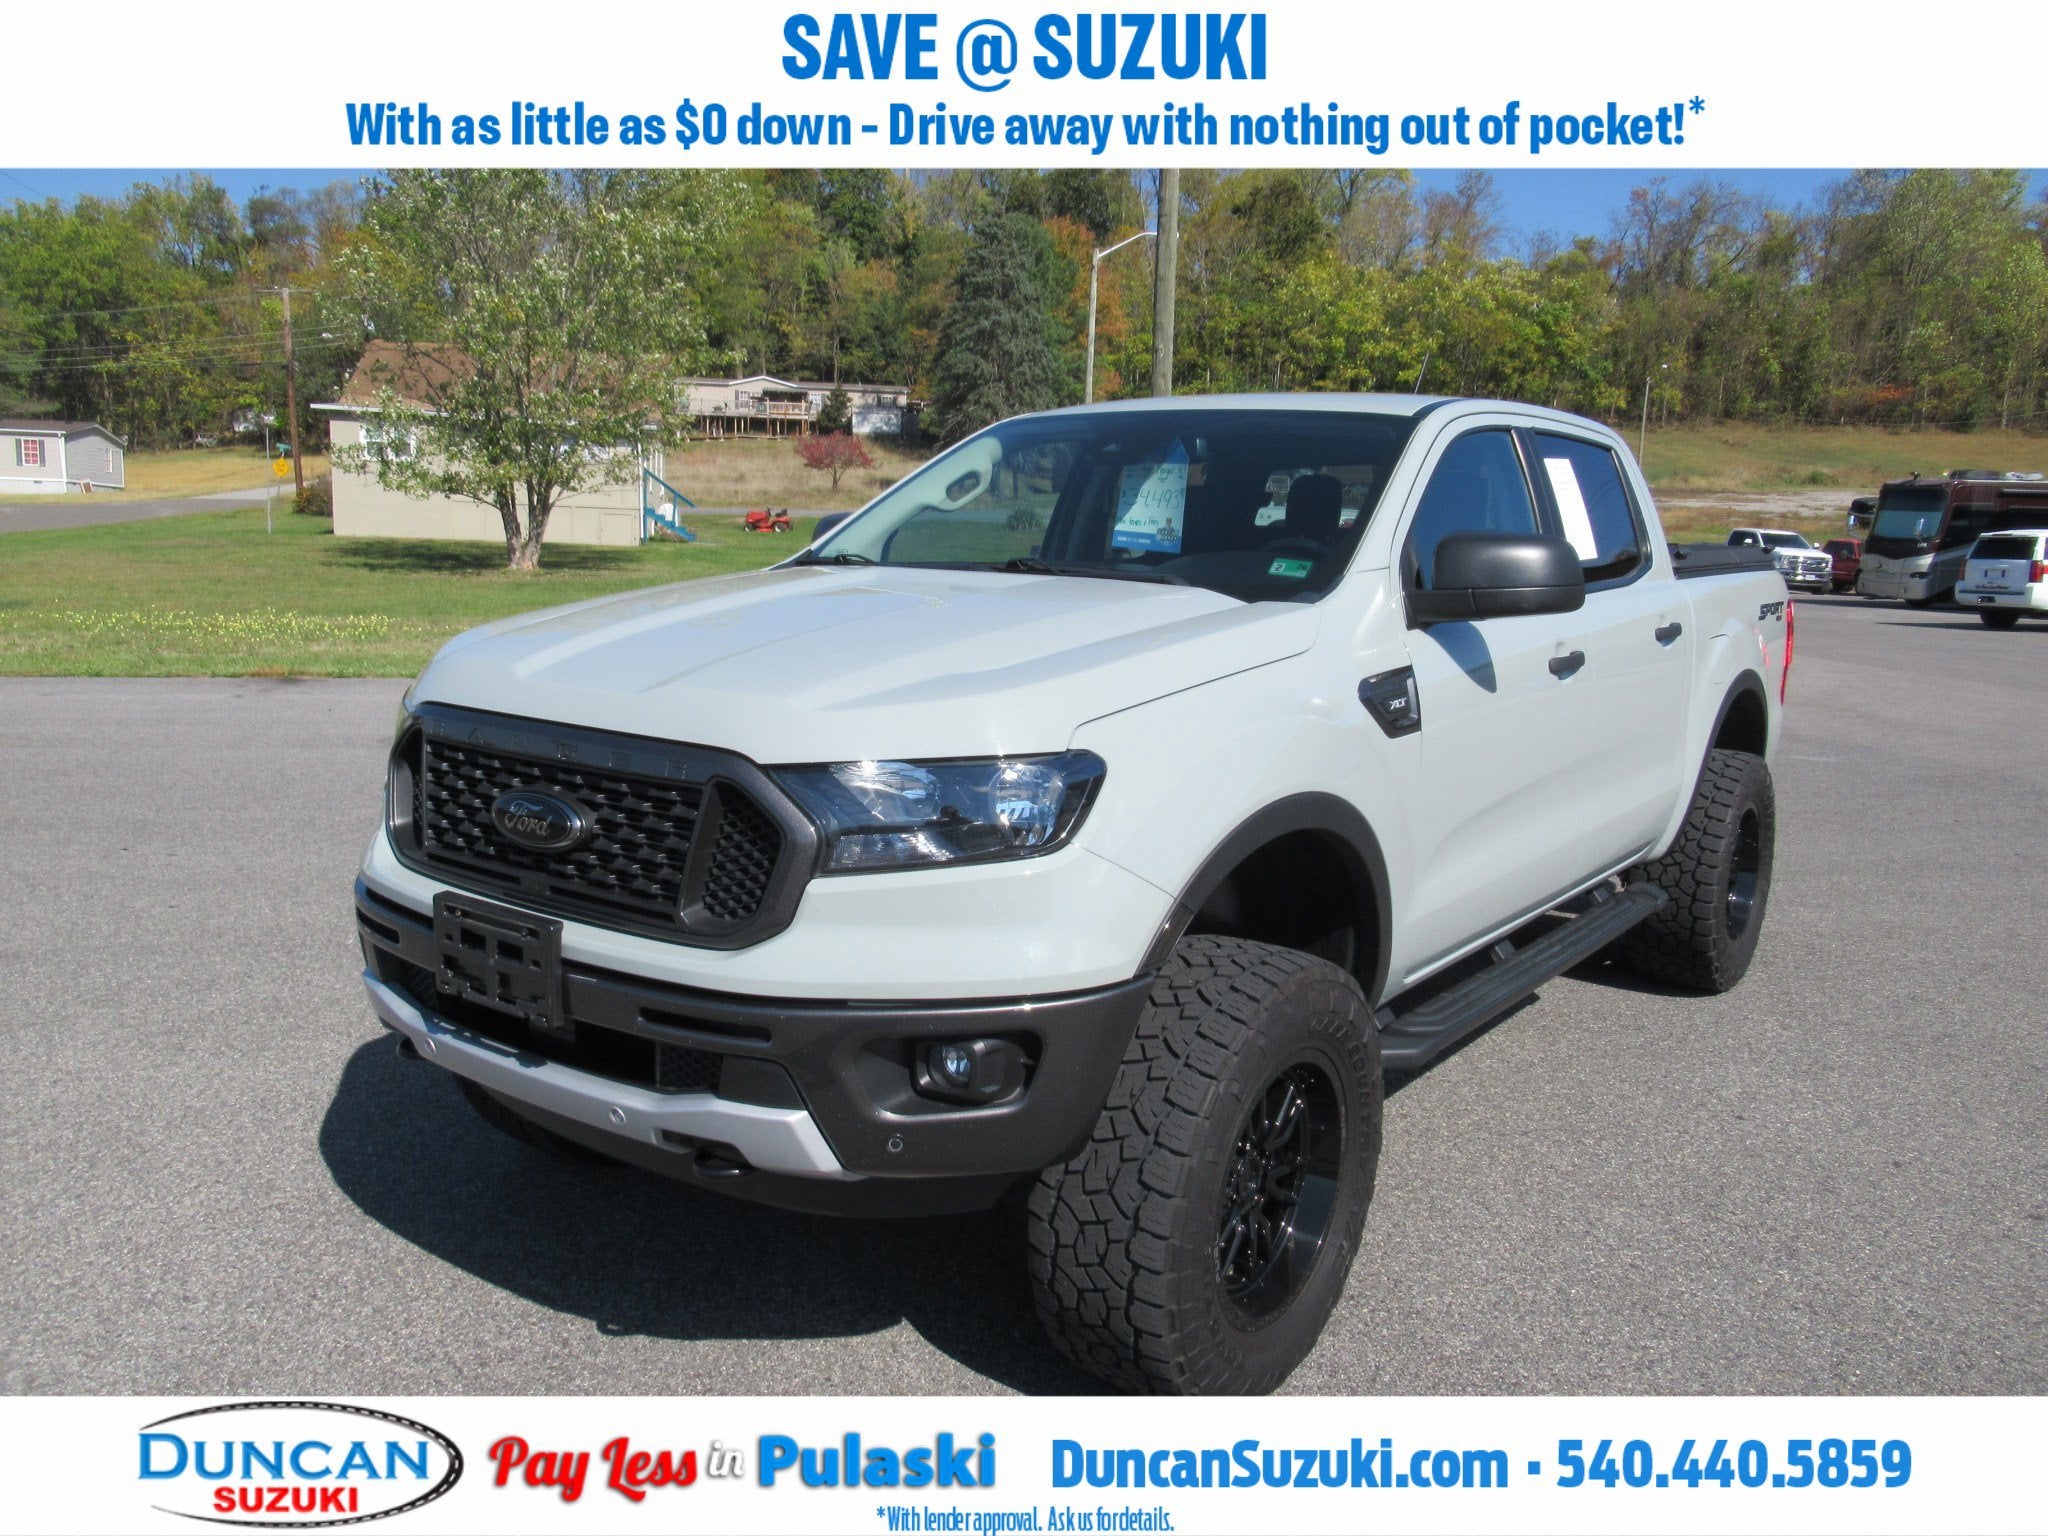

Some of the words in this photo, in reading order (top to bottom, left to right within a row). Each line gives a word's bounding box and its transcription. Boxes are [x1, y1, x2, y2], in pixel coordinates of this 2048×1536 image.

[1758, 601, 1784, 621] SPORT
[1389, 698, 1407, 710] XLT
[504, 800, 553, 836] Ford
